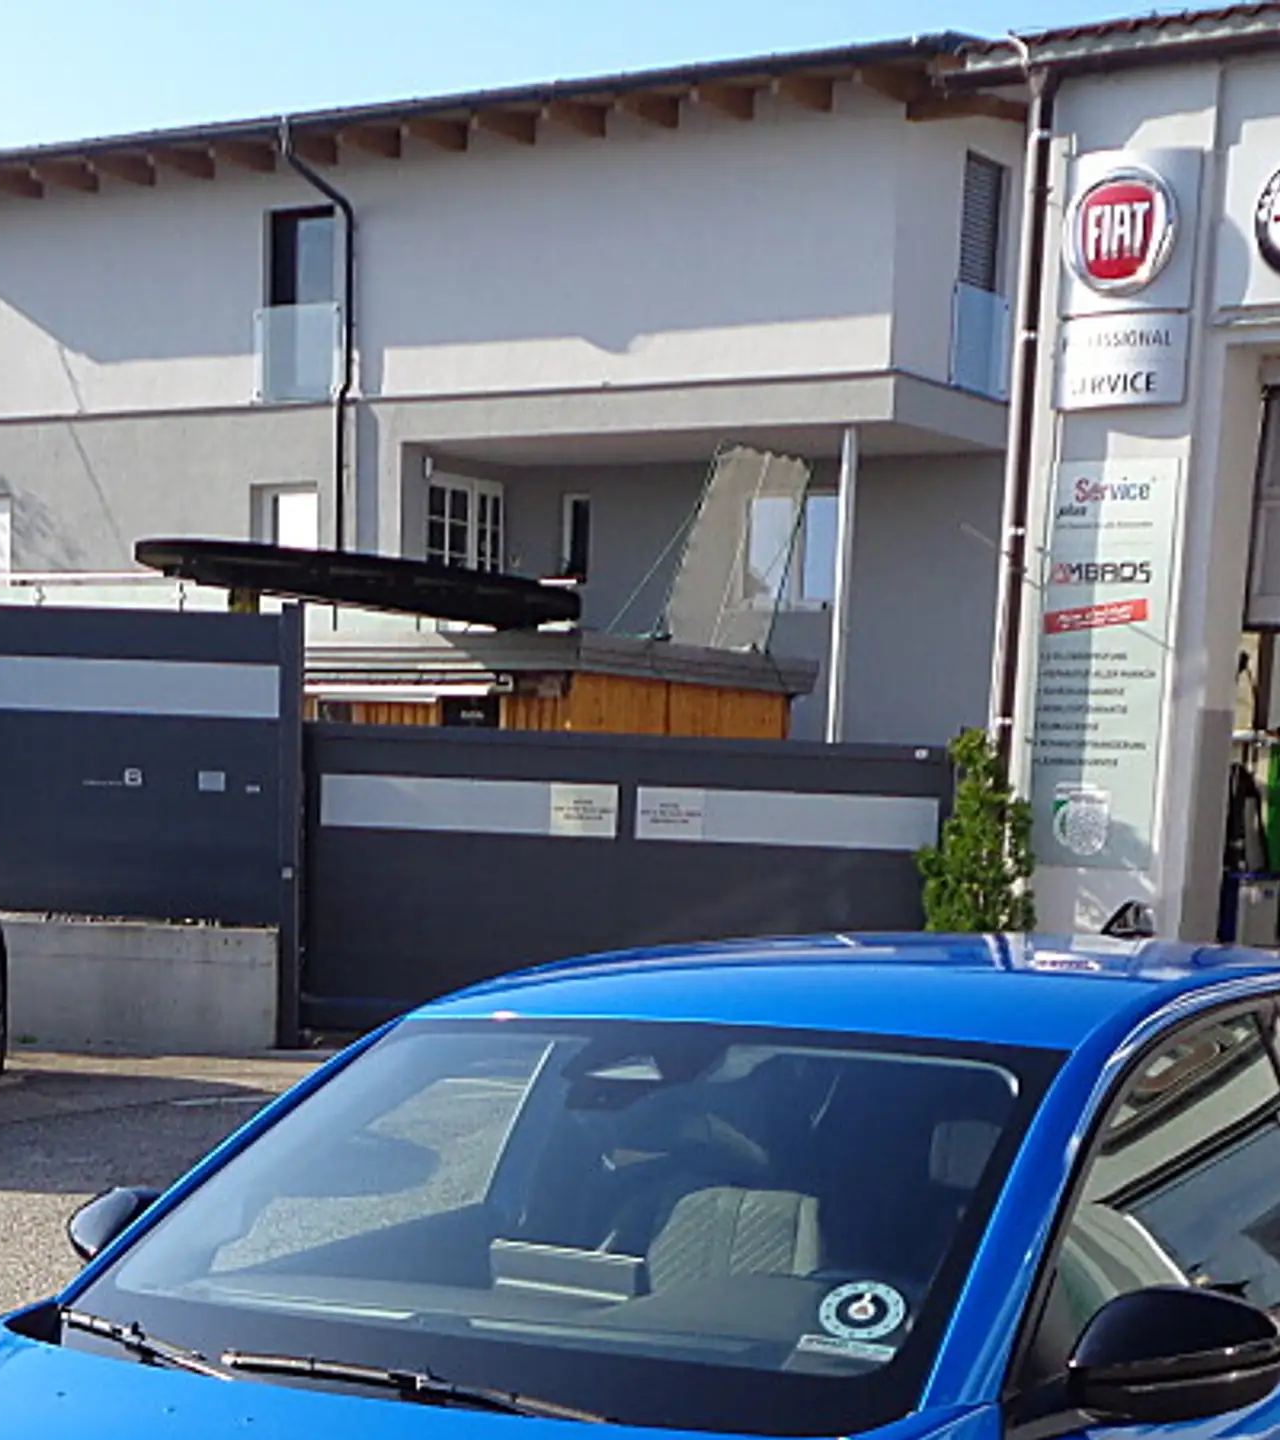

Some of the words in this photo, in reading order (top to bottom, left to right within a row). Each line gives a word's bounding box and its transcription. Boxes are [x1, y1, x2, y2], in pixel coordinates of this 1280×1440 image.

[1086, 201, 1152, 262] FIAT
[1071, 371, 1158, 395] RVICE
[1075, 476, 1151, 502] Service
